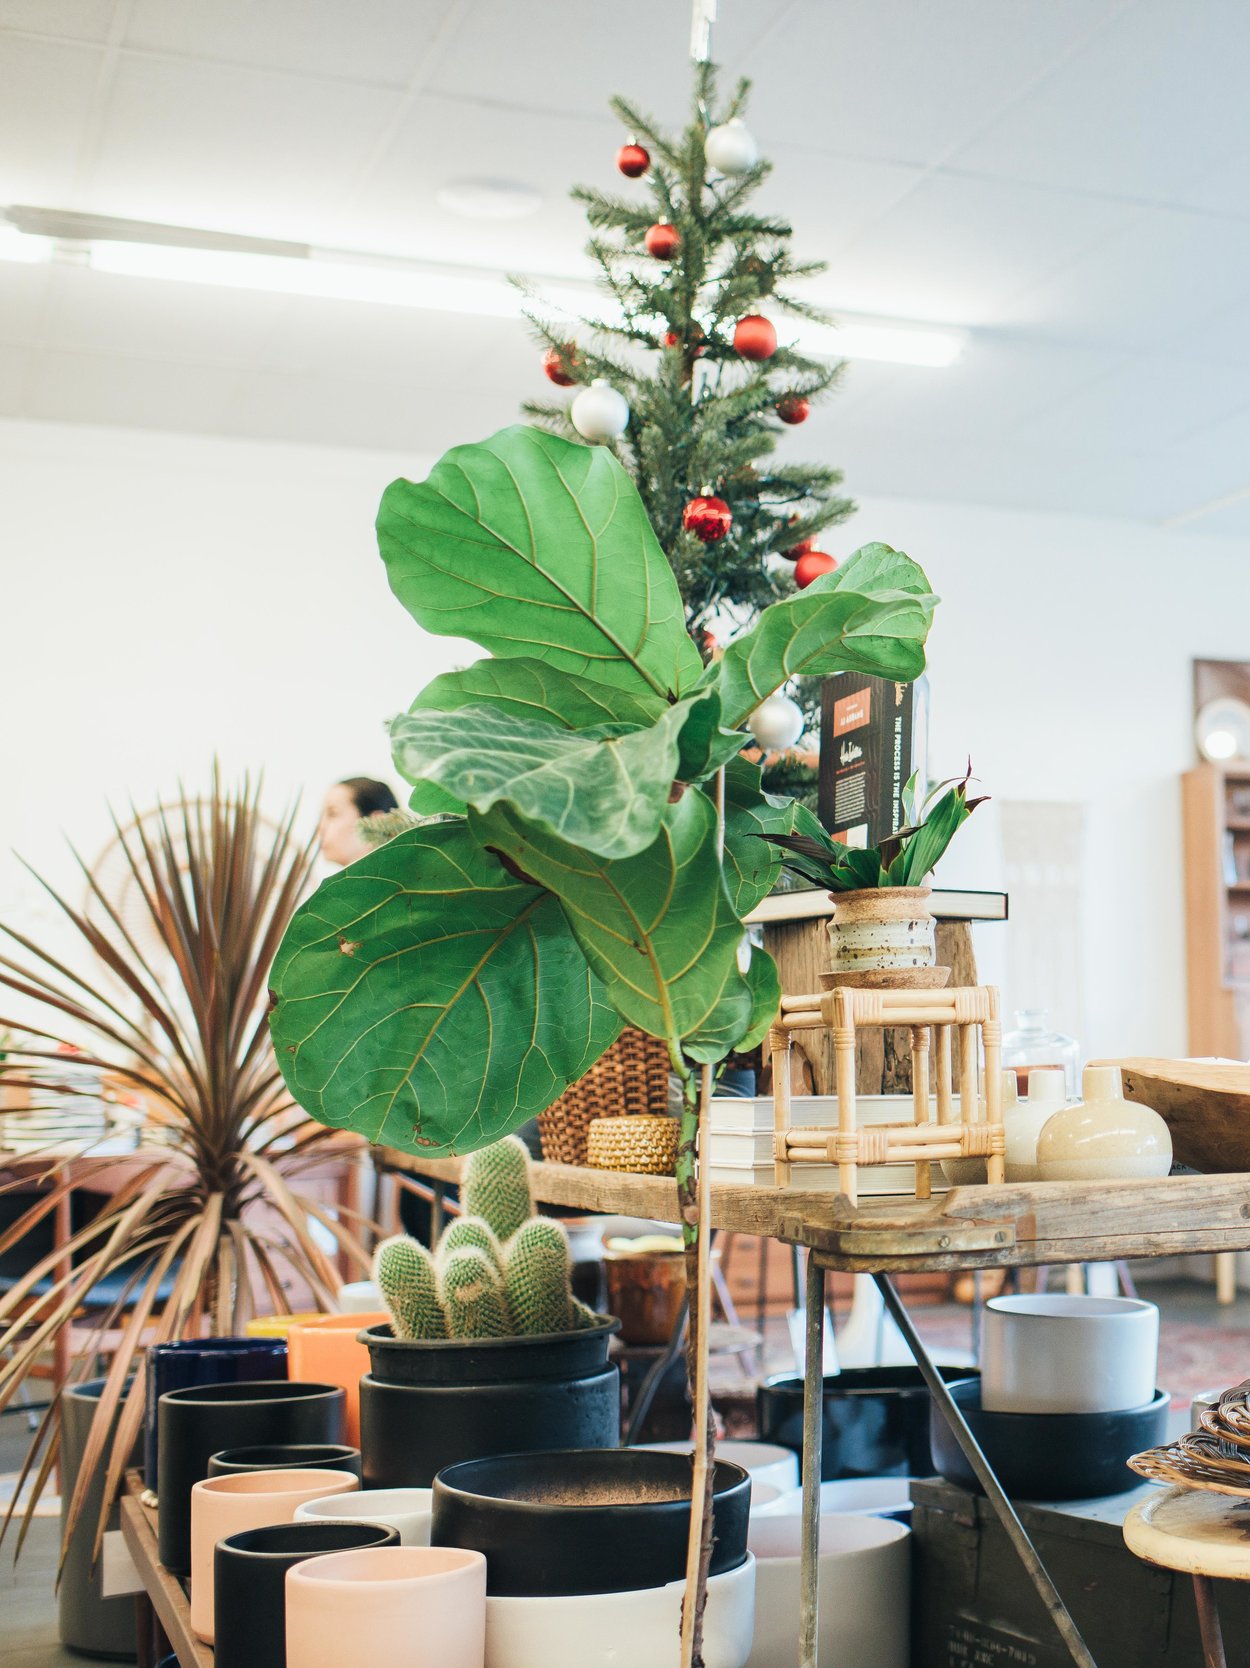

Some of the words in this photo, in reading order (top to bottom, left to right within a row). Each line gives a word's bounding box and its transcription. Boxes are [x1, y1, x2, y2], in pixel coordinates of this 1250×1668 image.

[894, 716, 902, 733] THE
[893, 733, 902, 771] PROCESS
[893, 772, 901, 780] IS
[892, 781, 900, 799] THE
